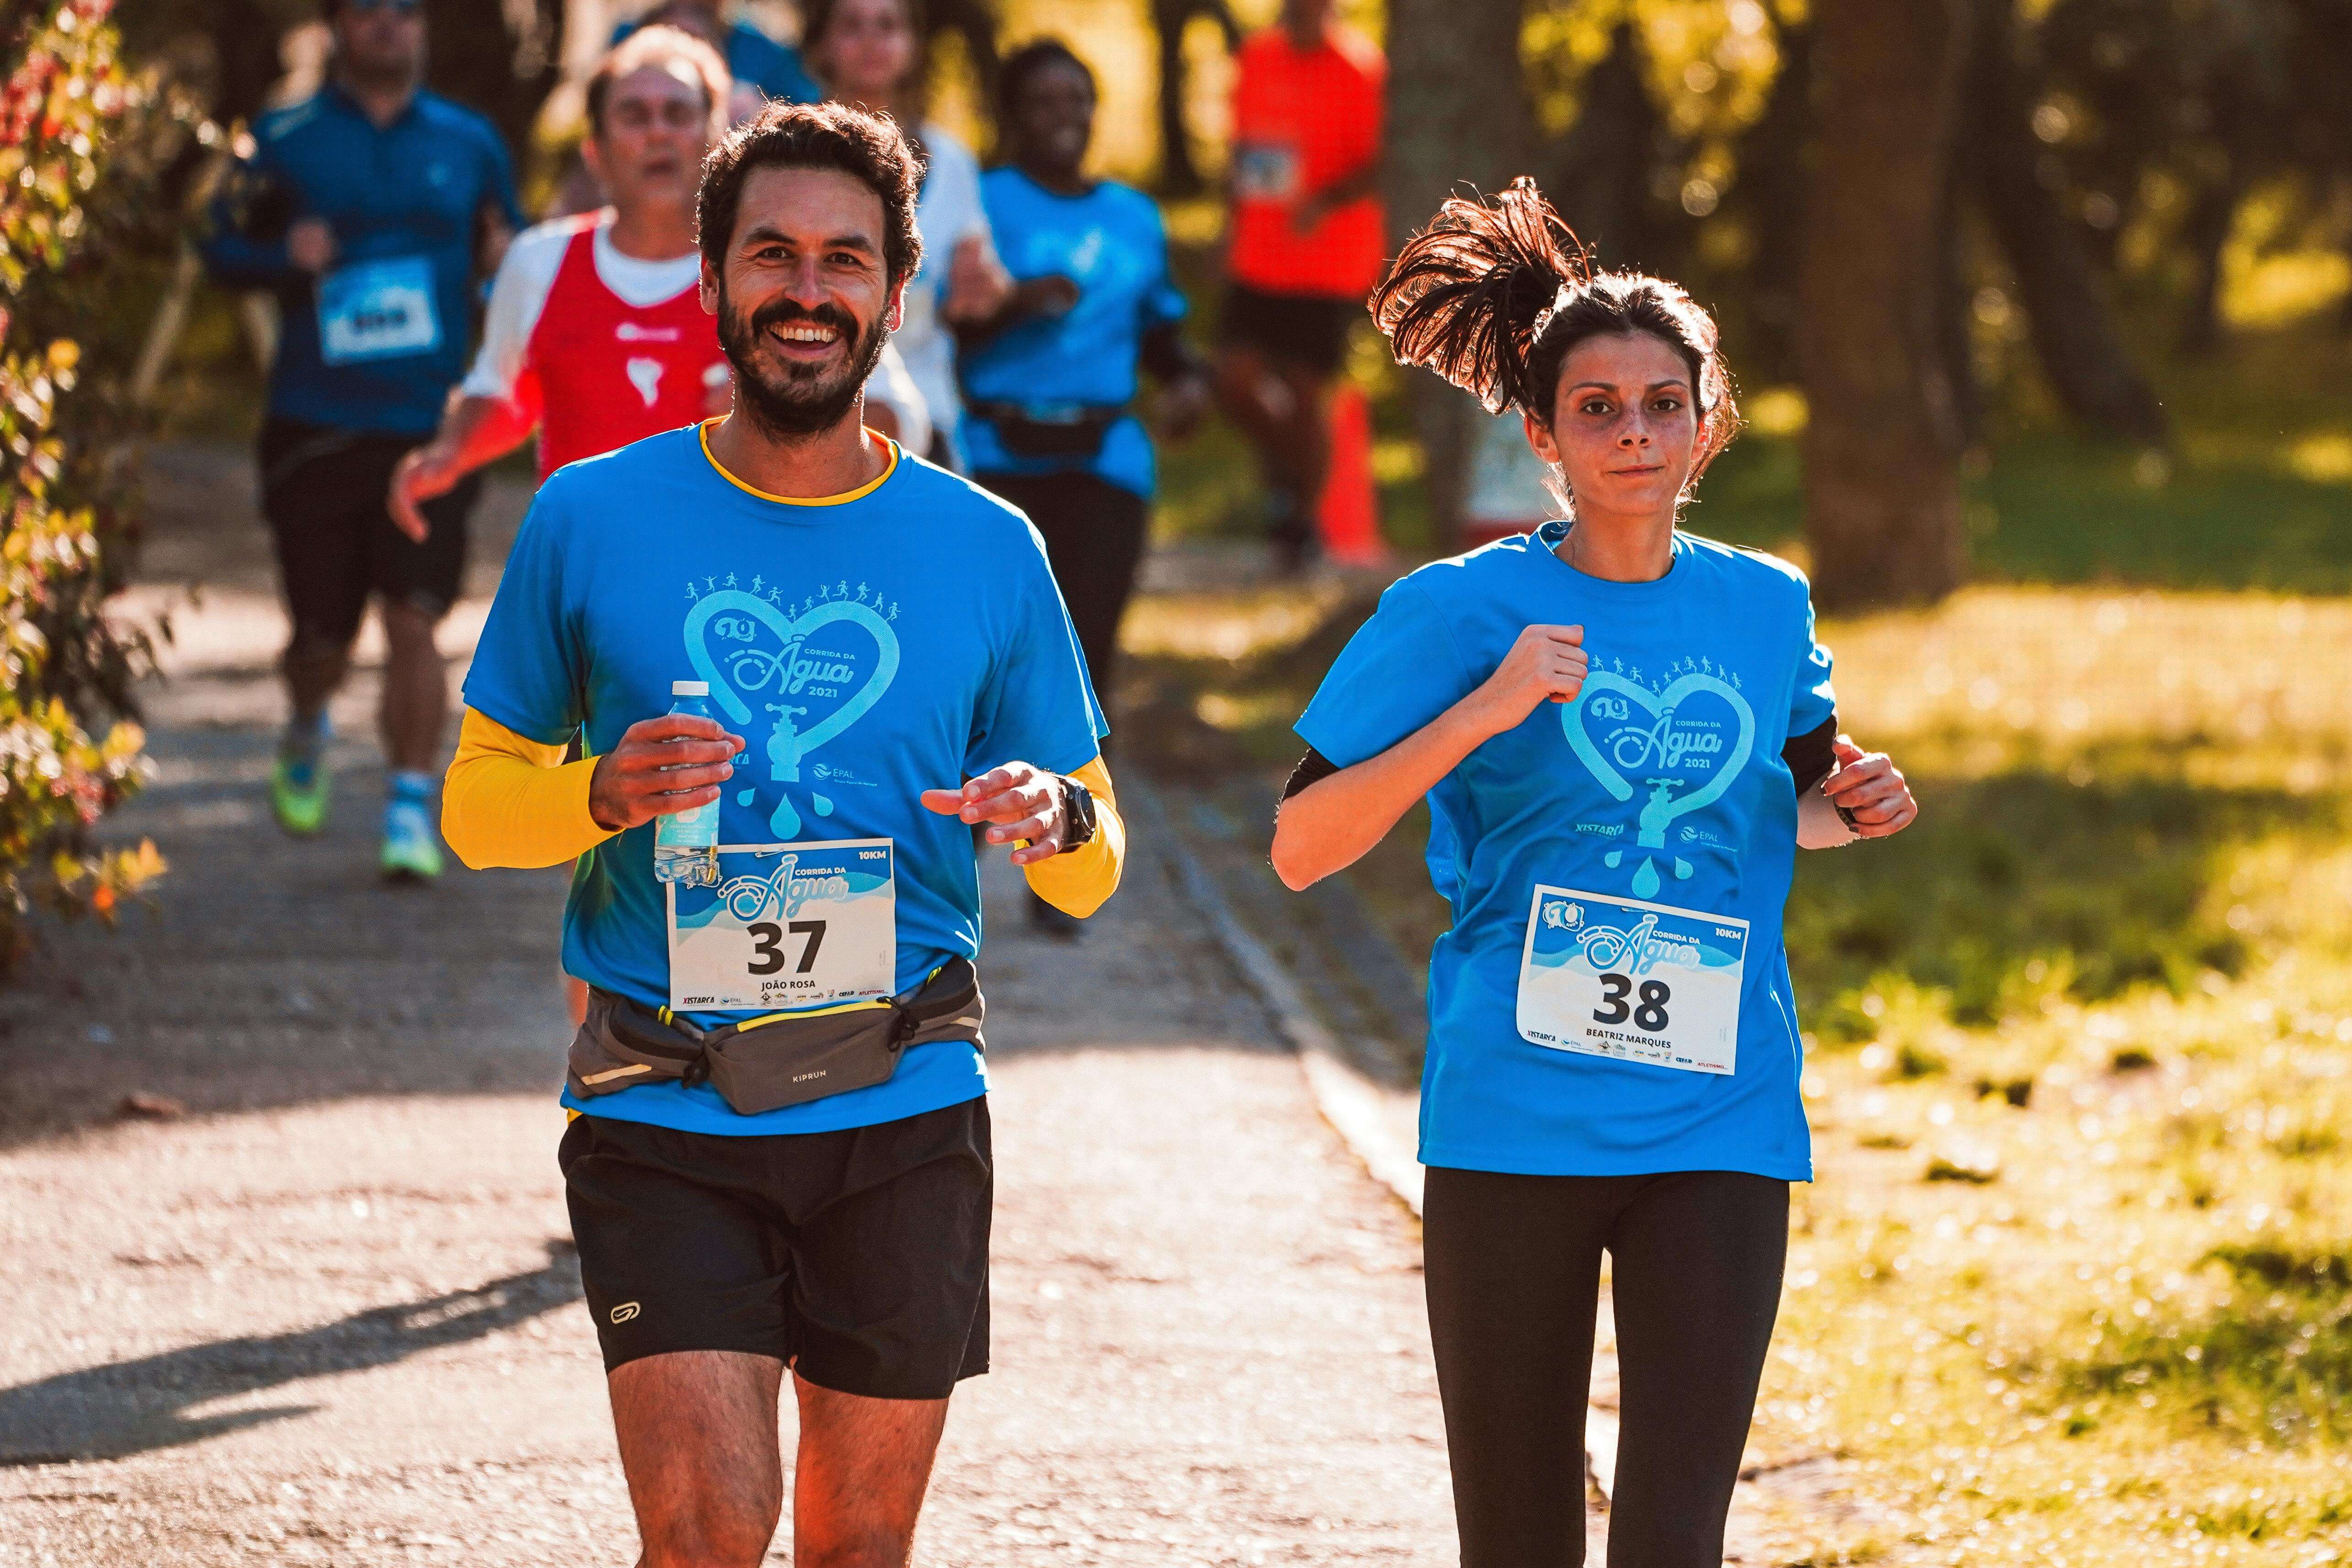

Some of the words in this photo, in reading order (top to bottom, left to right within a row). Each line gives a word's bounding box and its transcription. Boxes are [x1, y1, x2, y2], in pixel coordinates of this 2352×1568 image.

[804, 648, 841, 658] CORRIDA
[724, 635, 854, 695] Água
[809, 686, 838, 698] 2021
[1604, 709, 1723, 770] Água
[1684, 758, 1710, 769] 2021
[833, 769, 854, 779] EPAL
[1700, 831, 1718, 842] EPAL
[858, 850, 886, 860] 10KM
[794, 867, 832, 876] CORRIDA
[717, 853, 849, 922] Água
[1652, 930, 1687, 943] CORRIDA
[1689, 936, 1700, 945] DA
[1715, 928, 1742, 940] 10KM
[747, 920, 826, 976] 37
[1576, 913, 1701, 976] Água
[761, 980, 787, 992] JOÃO
[790, 980, 816, 989] ROSA
[1593, 973, 1671, 1032] 38
[1586, 1028, 1624, 1041] BEATRIZ
[1626, 1036, 1672, 1048] MARQUES
[793, 1070, 827, 1083] KIPRUN
